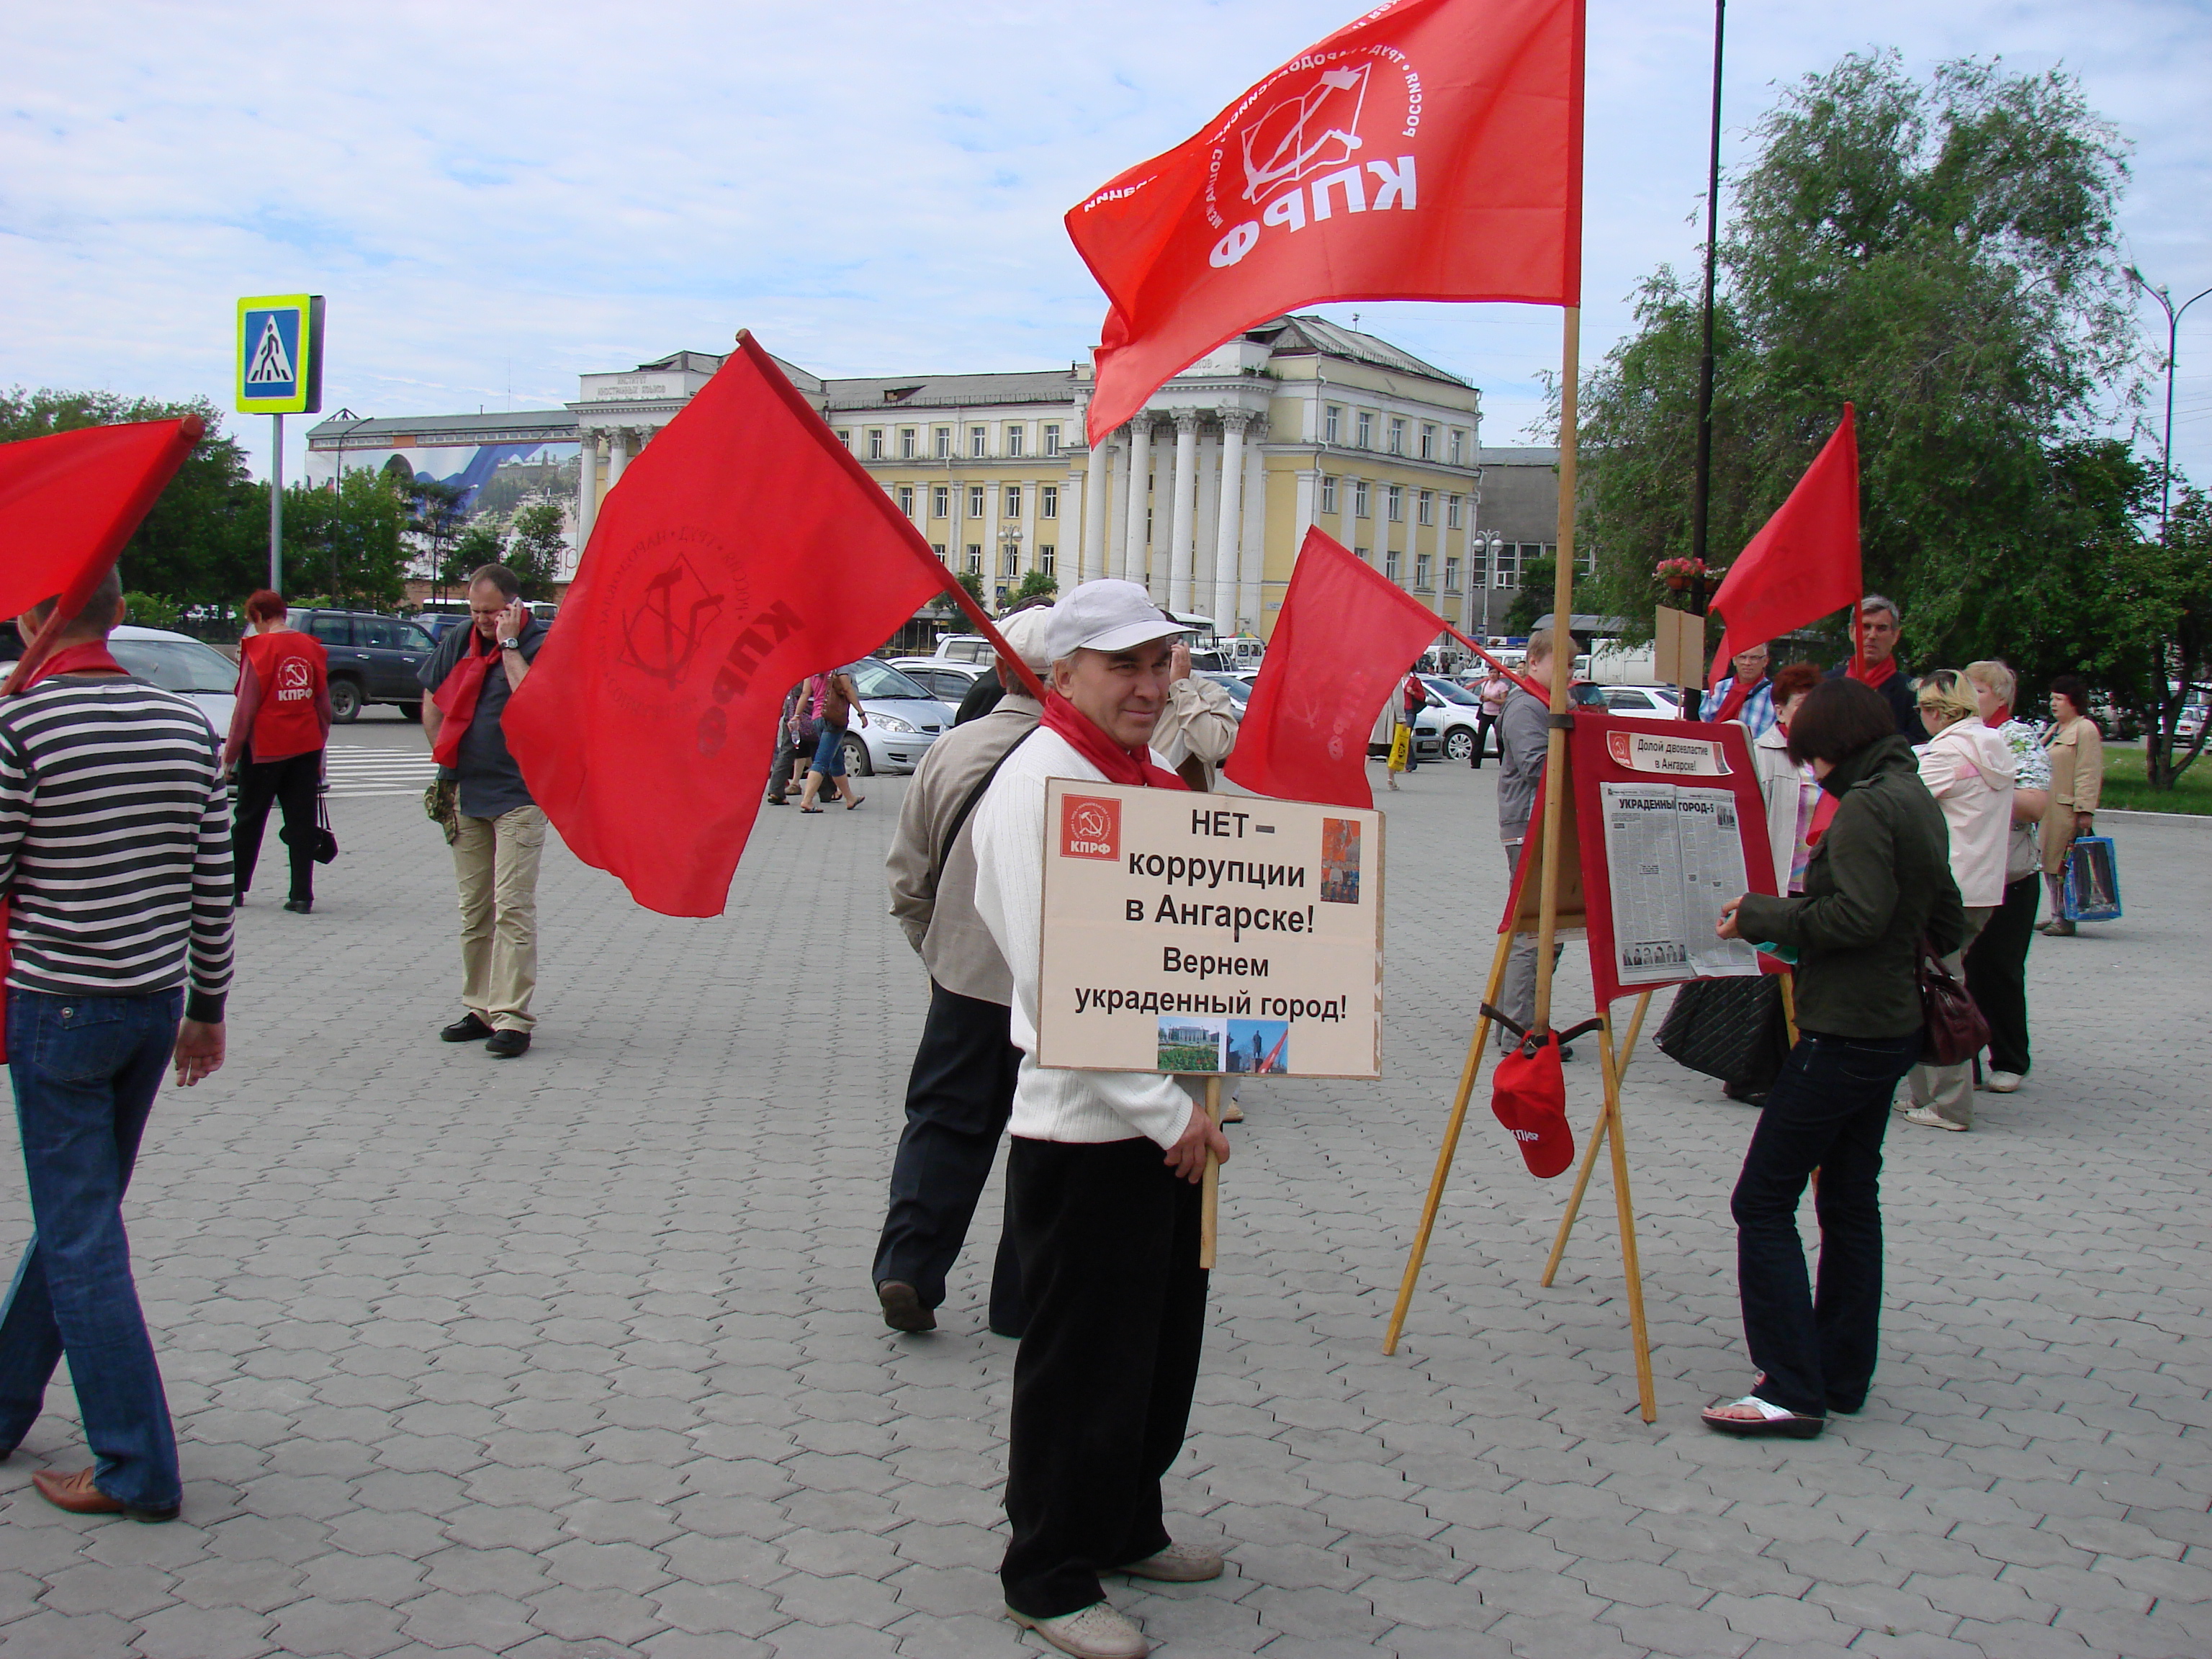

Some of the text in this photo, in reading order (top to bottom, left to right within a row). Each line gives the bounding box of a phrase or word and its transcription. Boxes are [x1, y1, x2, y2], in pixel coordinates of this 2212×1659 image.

[279, 688, 313, 701] КПРФ
[1637, 739, 1663, 752] Долой
[1665, 744, 1708, 755] двоевластие
[1662, 758, 1696, 773] Ангарске!
[1192, 809, 1249, 838] НЕТ
[1071, 840, 1110, 855] КПРФ
[1129, 853, 1305, 890] коррупции
[1126, 894, 1314, 943] в Ангарске!
[1164, 946, 1269, 980] Вернем
[1075, 987, 1347, 1023] украденный город!
